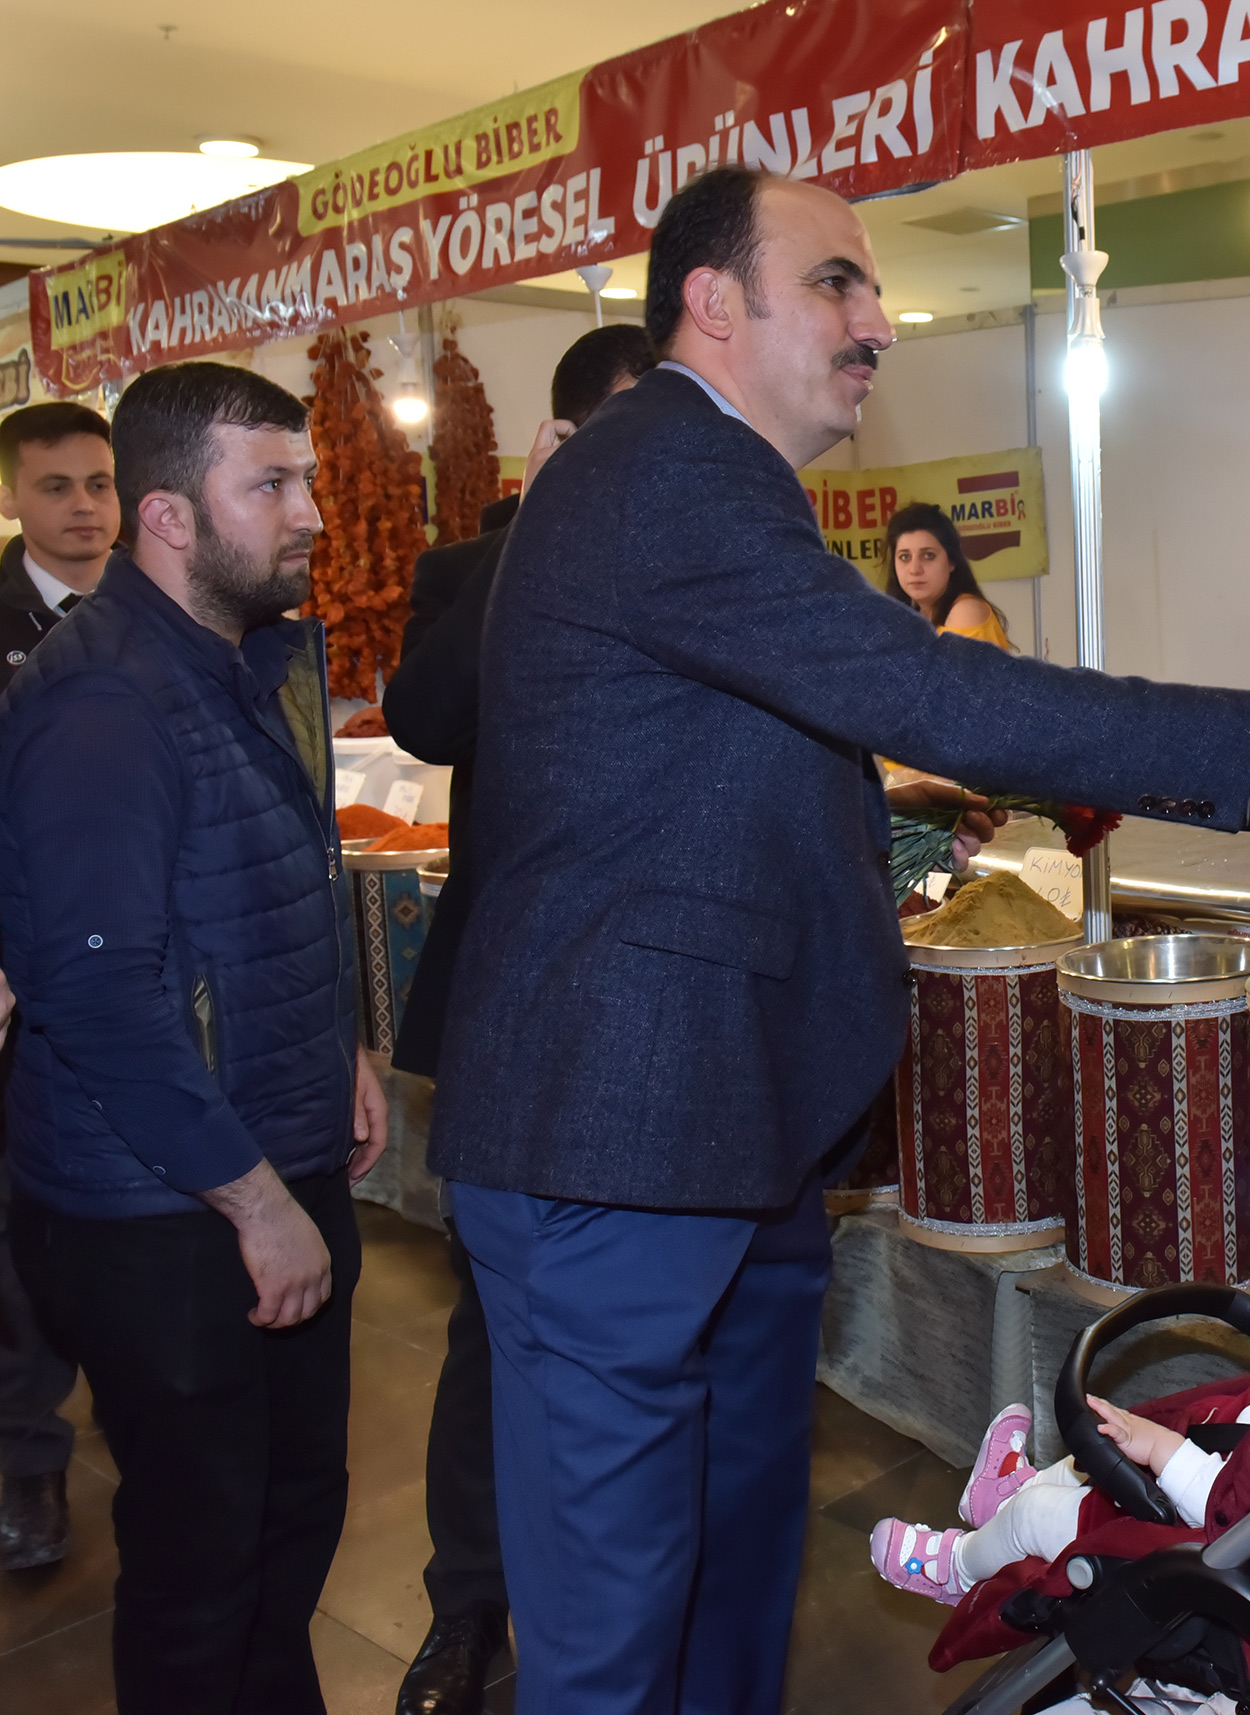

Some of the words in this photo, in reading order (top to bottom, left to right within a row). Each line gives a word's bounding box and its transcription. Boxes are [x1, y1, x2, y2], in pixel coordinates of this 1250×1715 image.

[311, 139, 464, 222] GÖDEOĞLU
[475, 107, 563, 171] BİBER
[424, 167, 615, 281] YÖRESEL
[951, 493, 1016, 522] MARBİ
[1029, 856, 1082, 879] KİMYO
